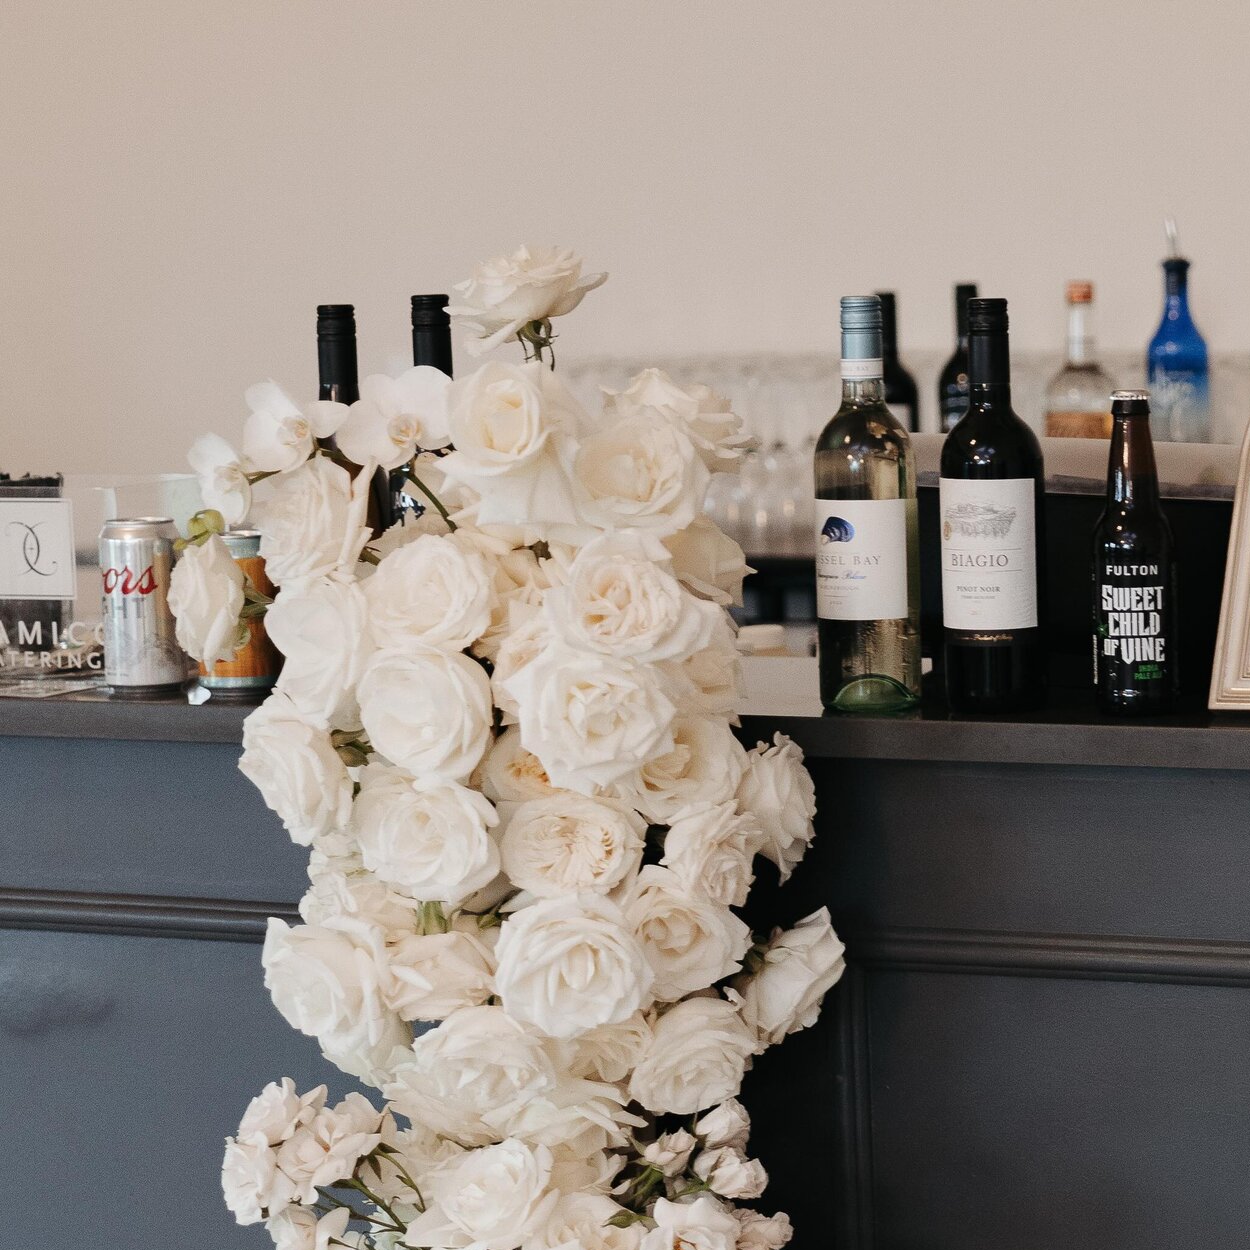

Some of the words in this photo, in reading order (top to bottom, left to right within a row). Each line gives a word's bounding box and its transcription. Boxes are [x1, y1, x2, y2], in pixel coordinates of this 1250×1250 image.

[816, 555, 846, 565] SSEL
[853, 555, 881, 565] BAY
[951, 554, 1009, 567] BIAGIO
[1106, 564, 1158, 576] FULTON
[102, 566, 158, 595] ors
[1101, 584, 1164, 611] SWEET
[1108, 612, 1160, 636] CHILD
[1103, 639, 1119, 656] OF
[1120, 637, 1165, 664] VINE
